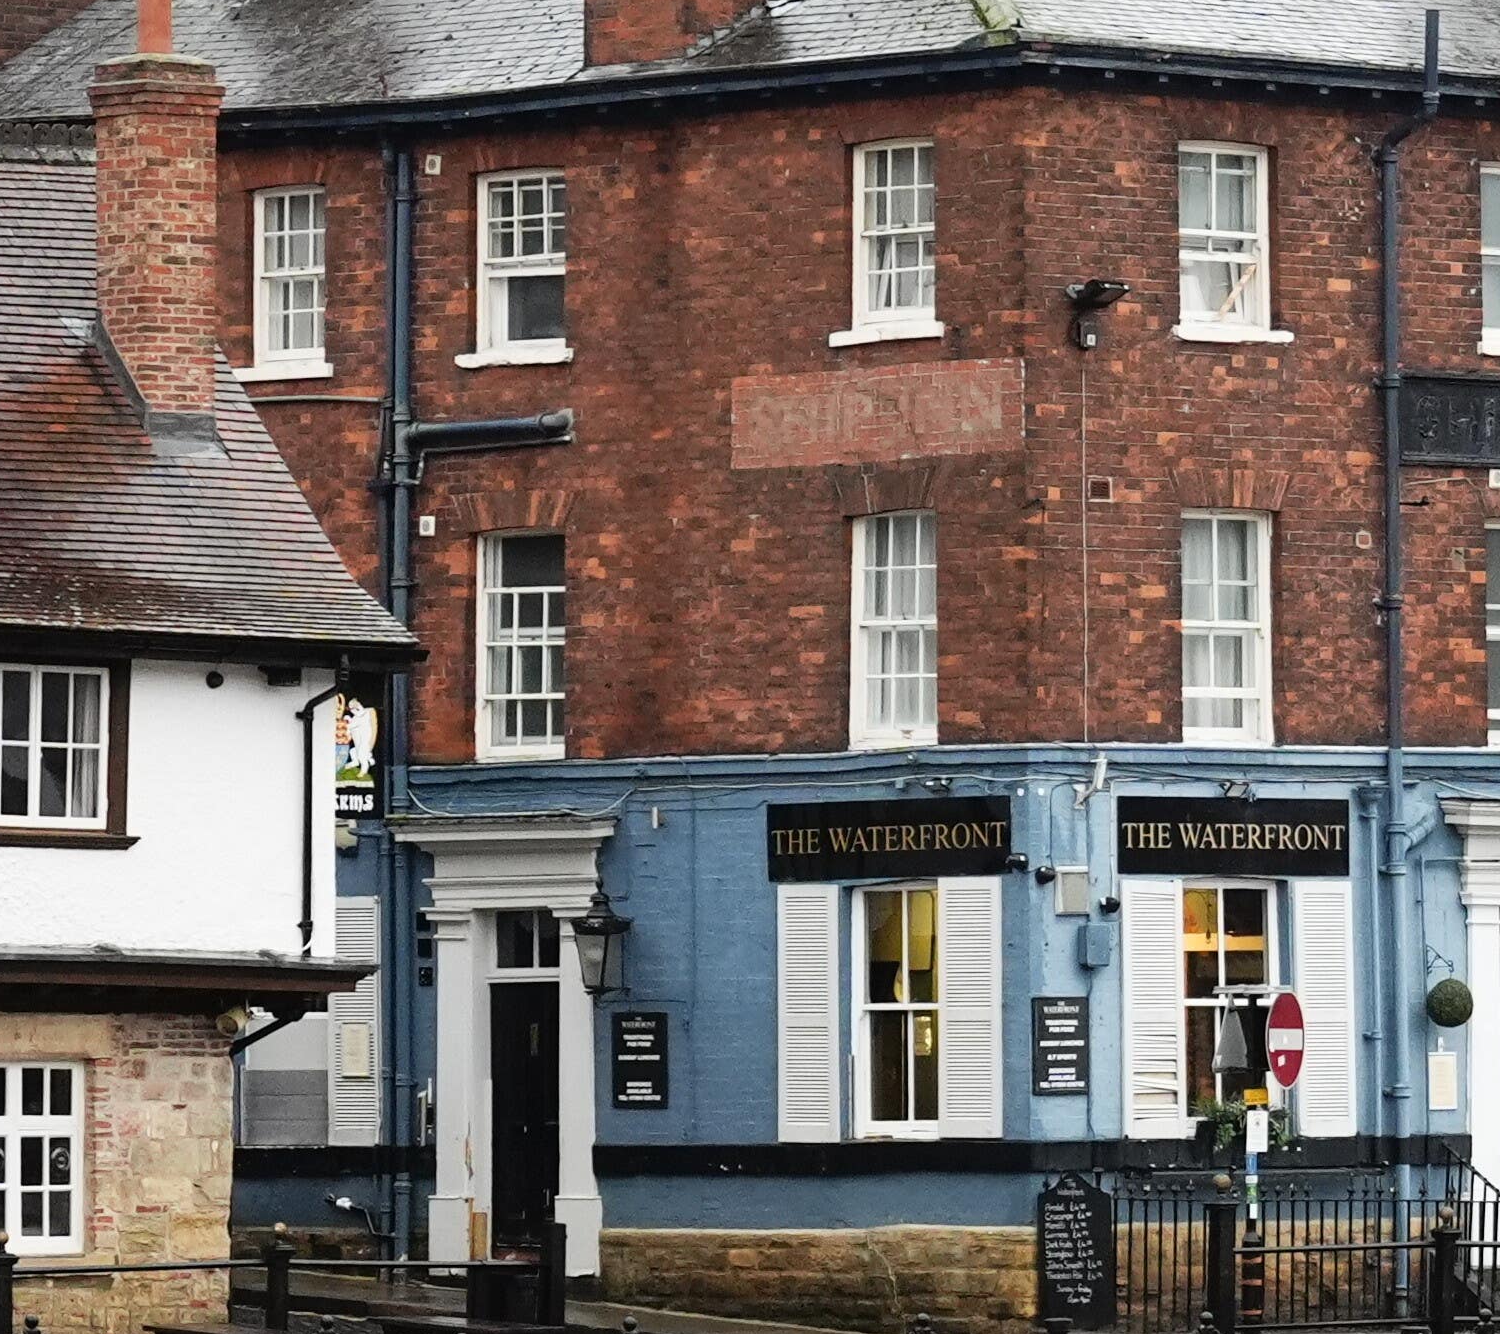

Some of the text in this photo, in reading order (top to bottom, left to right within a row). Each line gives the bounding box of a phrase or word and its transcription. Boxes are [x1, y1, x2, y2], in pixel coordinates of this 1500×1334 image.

[771, 821, 1007, 856] THE WATERFRONT
[1121, 822, 1346, 851] THE WATERFRONT
